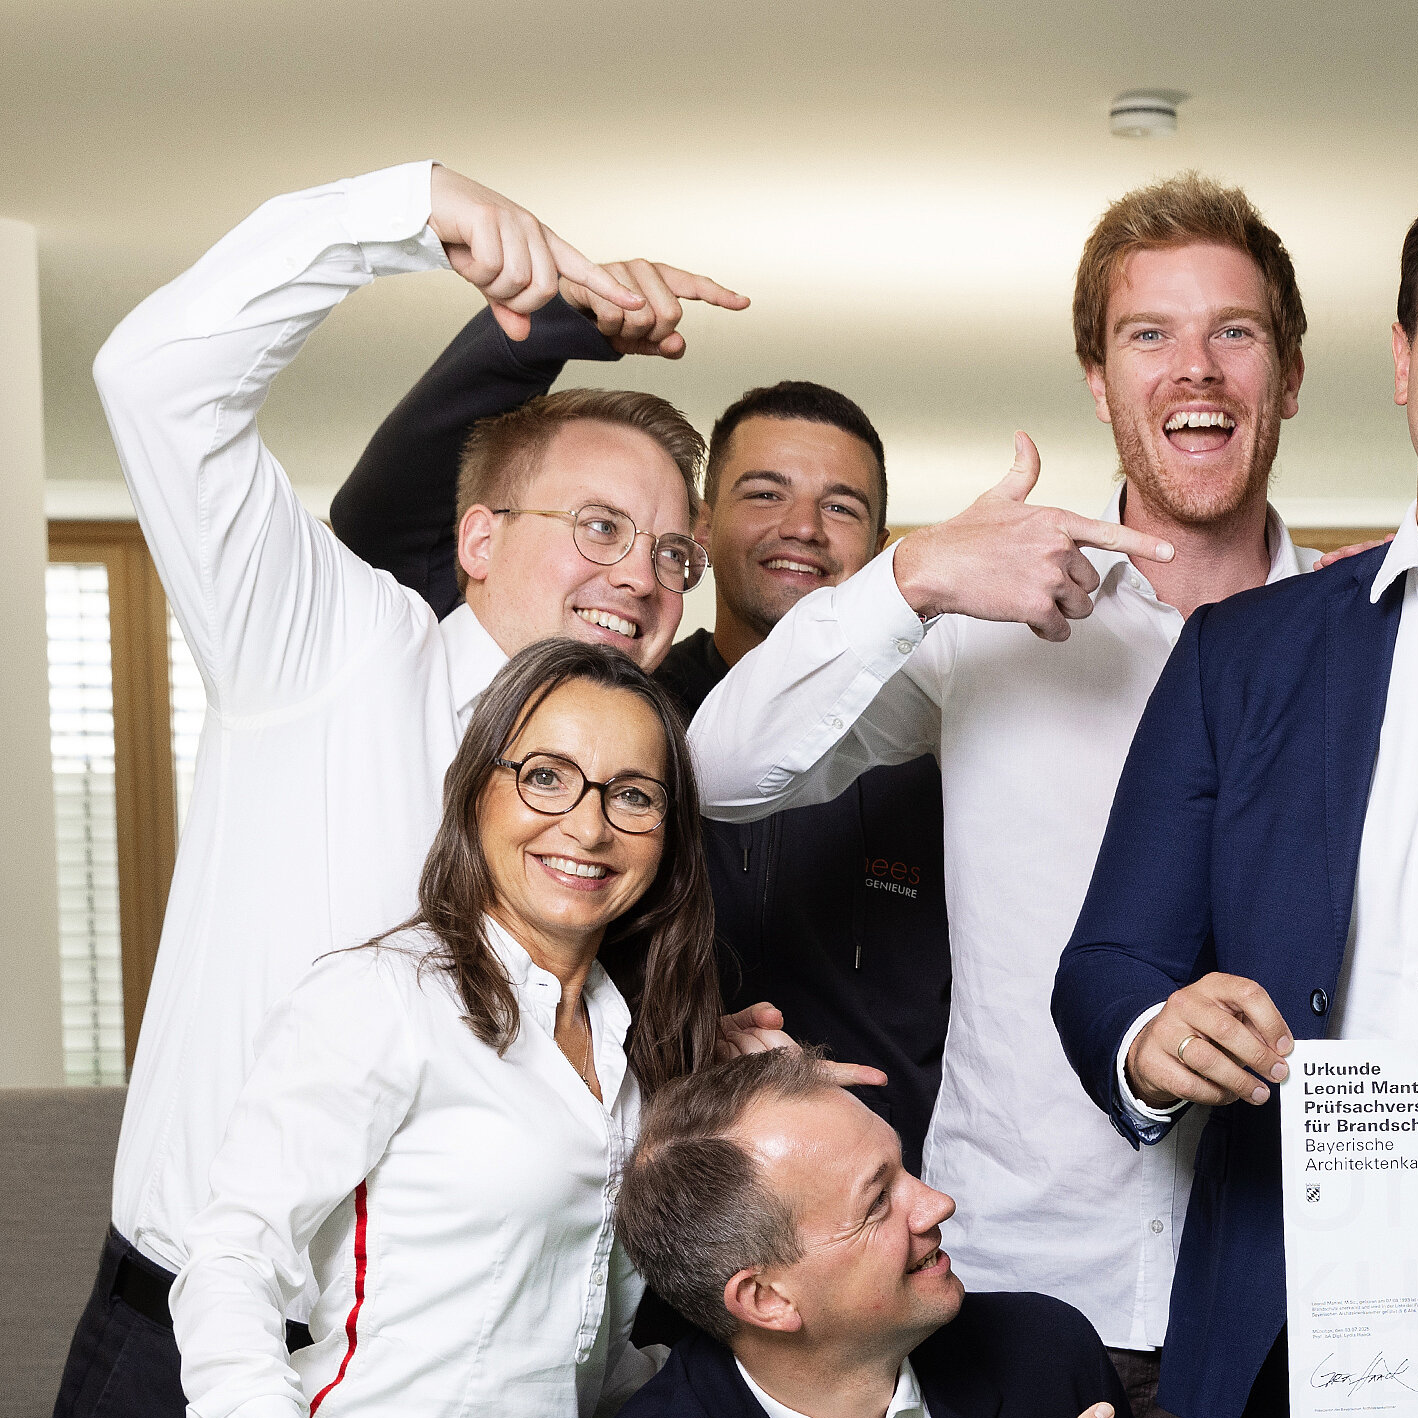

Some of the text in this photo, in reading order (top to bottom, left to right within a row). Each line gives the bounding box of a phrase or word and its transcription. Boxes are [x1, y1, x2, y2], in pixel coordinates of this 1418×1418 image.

[865, 857, 921, 885] ees
[865, 878, 918, 899] GENIEURE
[1303, 1061, 1381, 1077] Urkunde
[1304, 1081, 1365, 1095] Leonid
[1304, 1118, 1331, 1133] für
[1305, 1137, 1395, 1155] Bayerische
